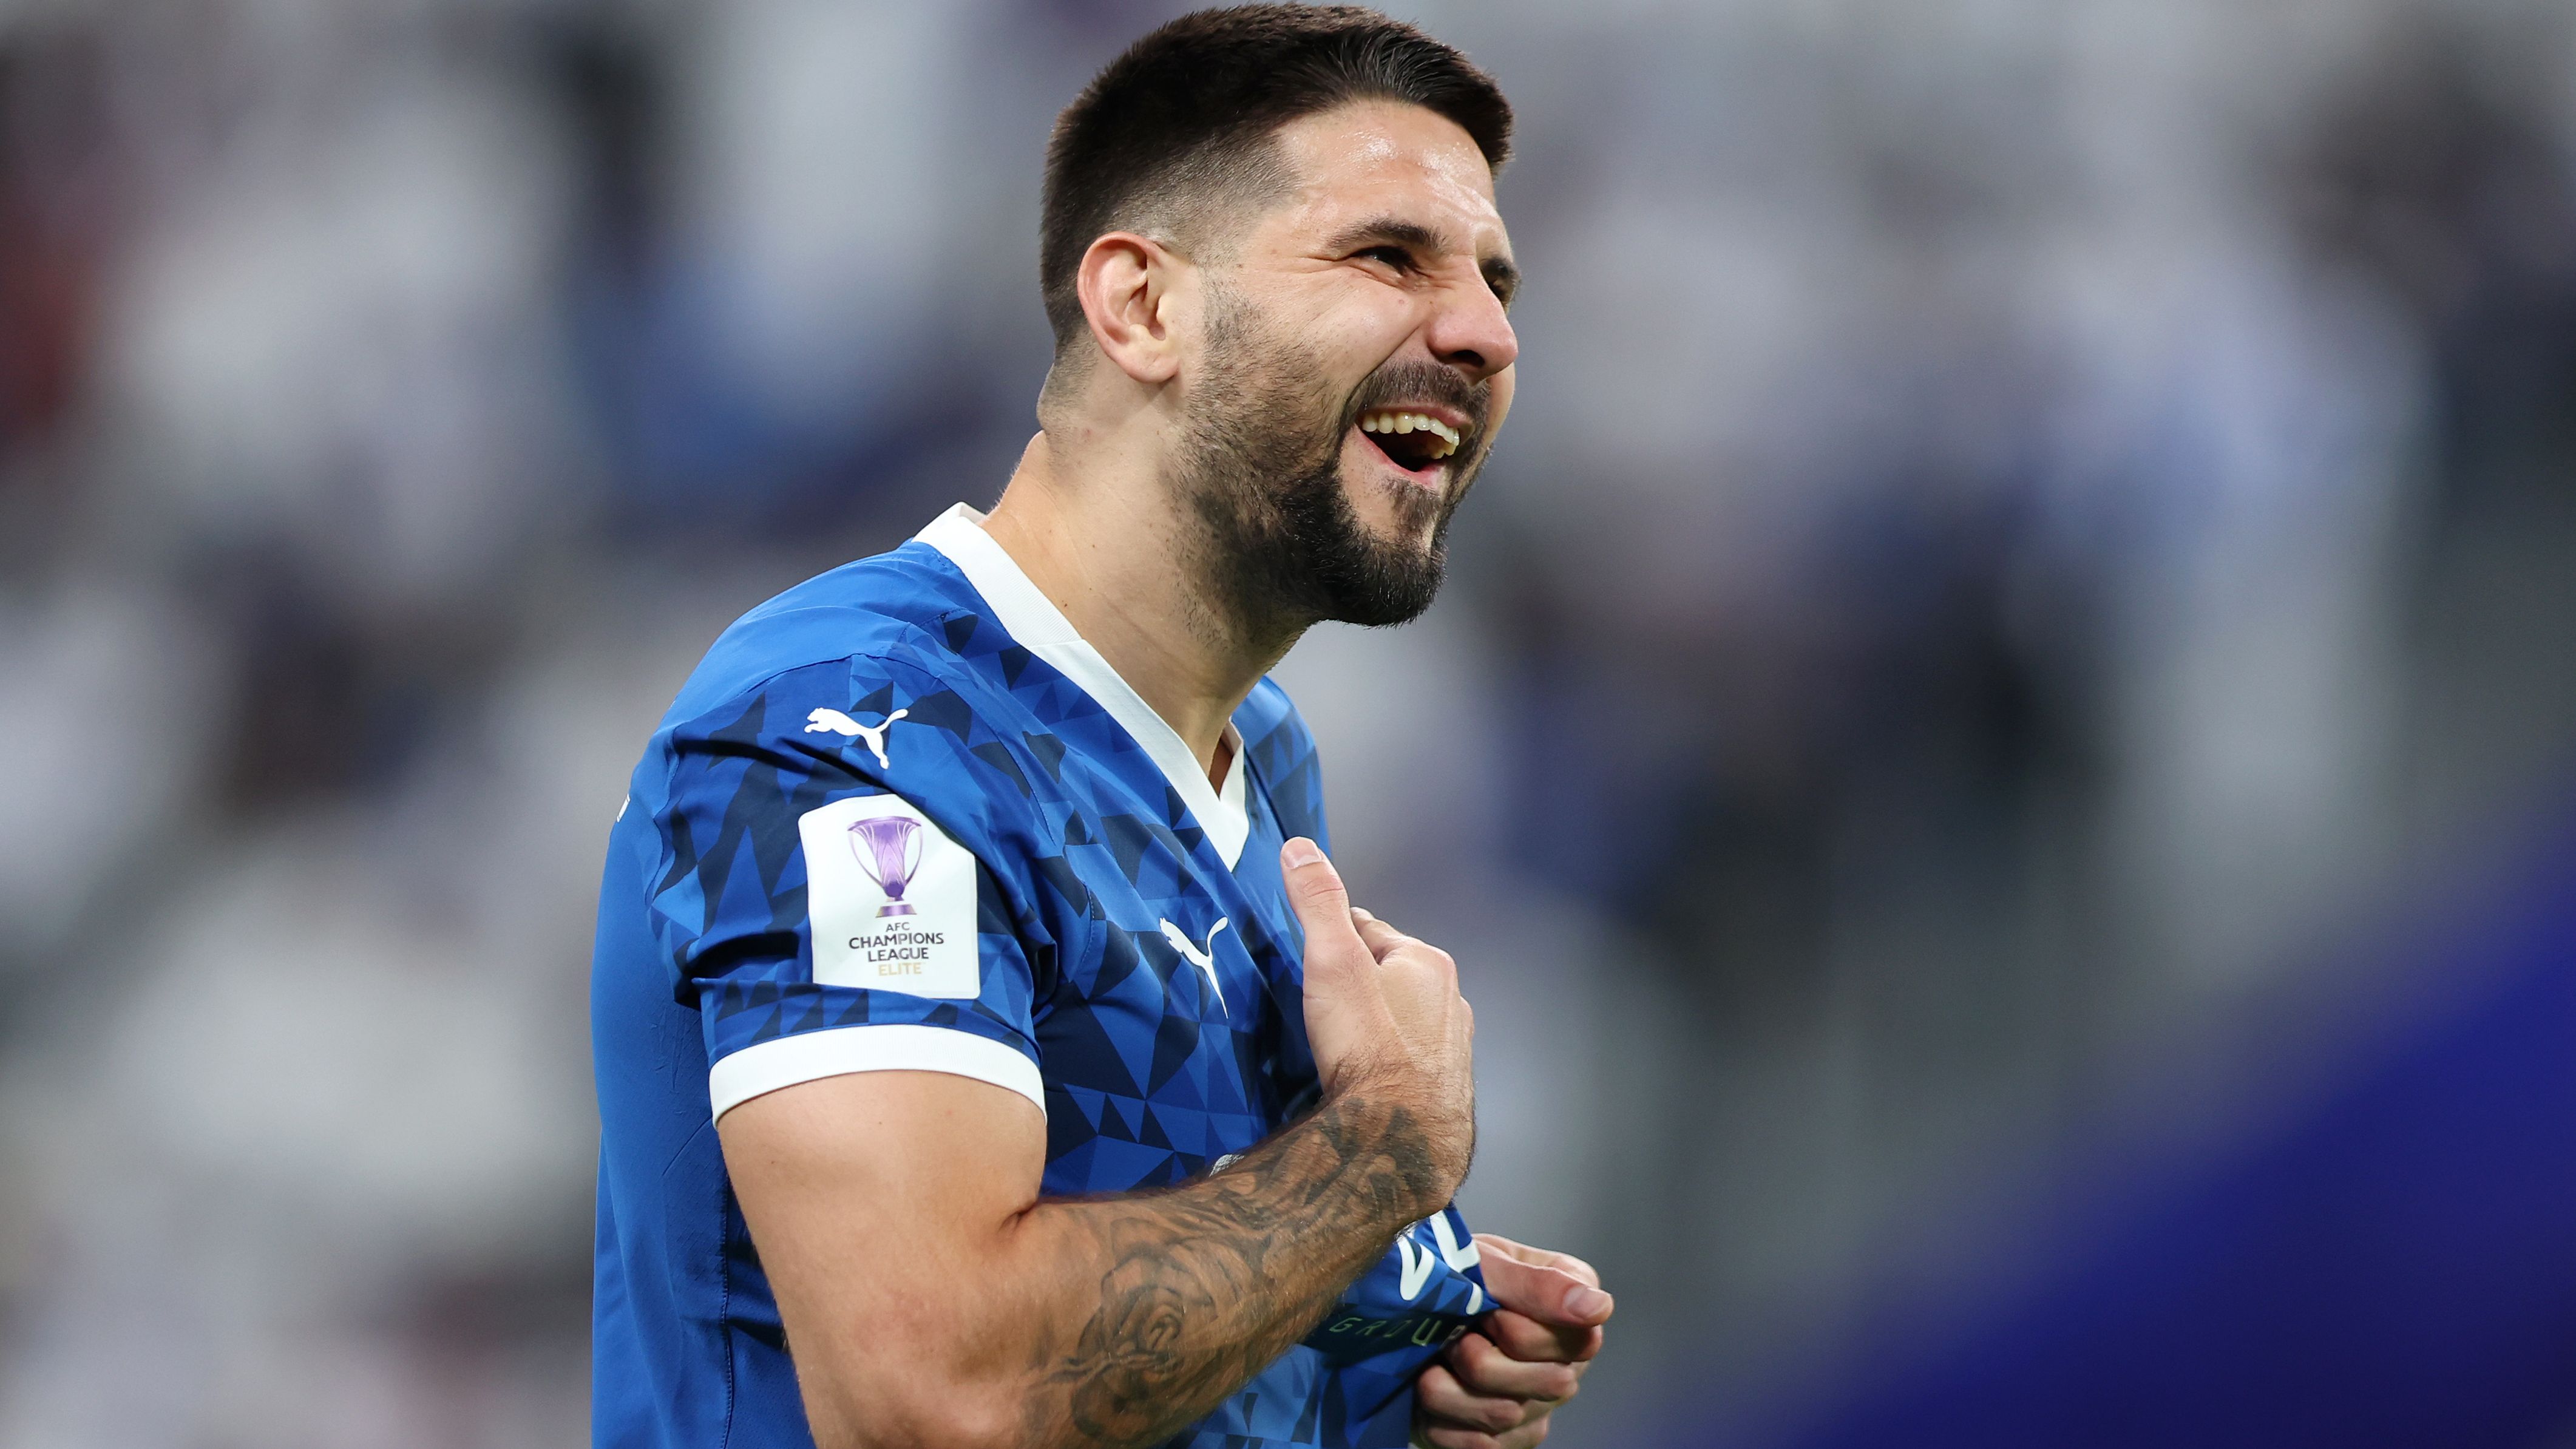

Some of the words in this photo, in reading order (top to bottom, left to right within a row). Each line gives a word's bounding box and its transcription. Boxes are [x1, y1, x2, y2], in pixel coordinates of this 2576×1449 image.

[886, 922, 910, 932] AFC
[849, 932, 944, 949] CHAMPIONS
[867, 947, 929, 962] LEAGUE
[878, 962, 923, 977] ELITE
